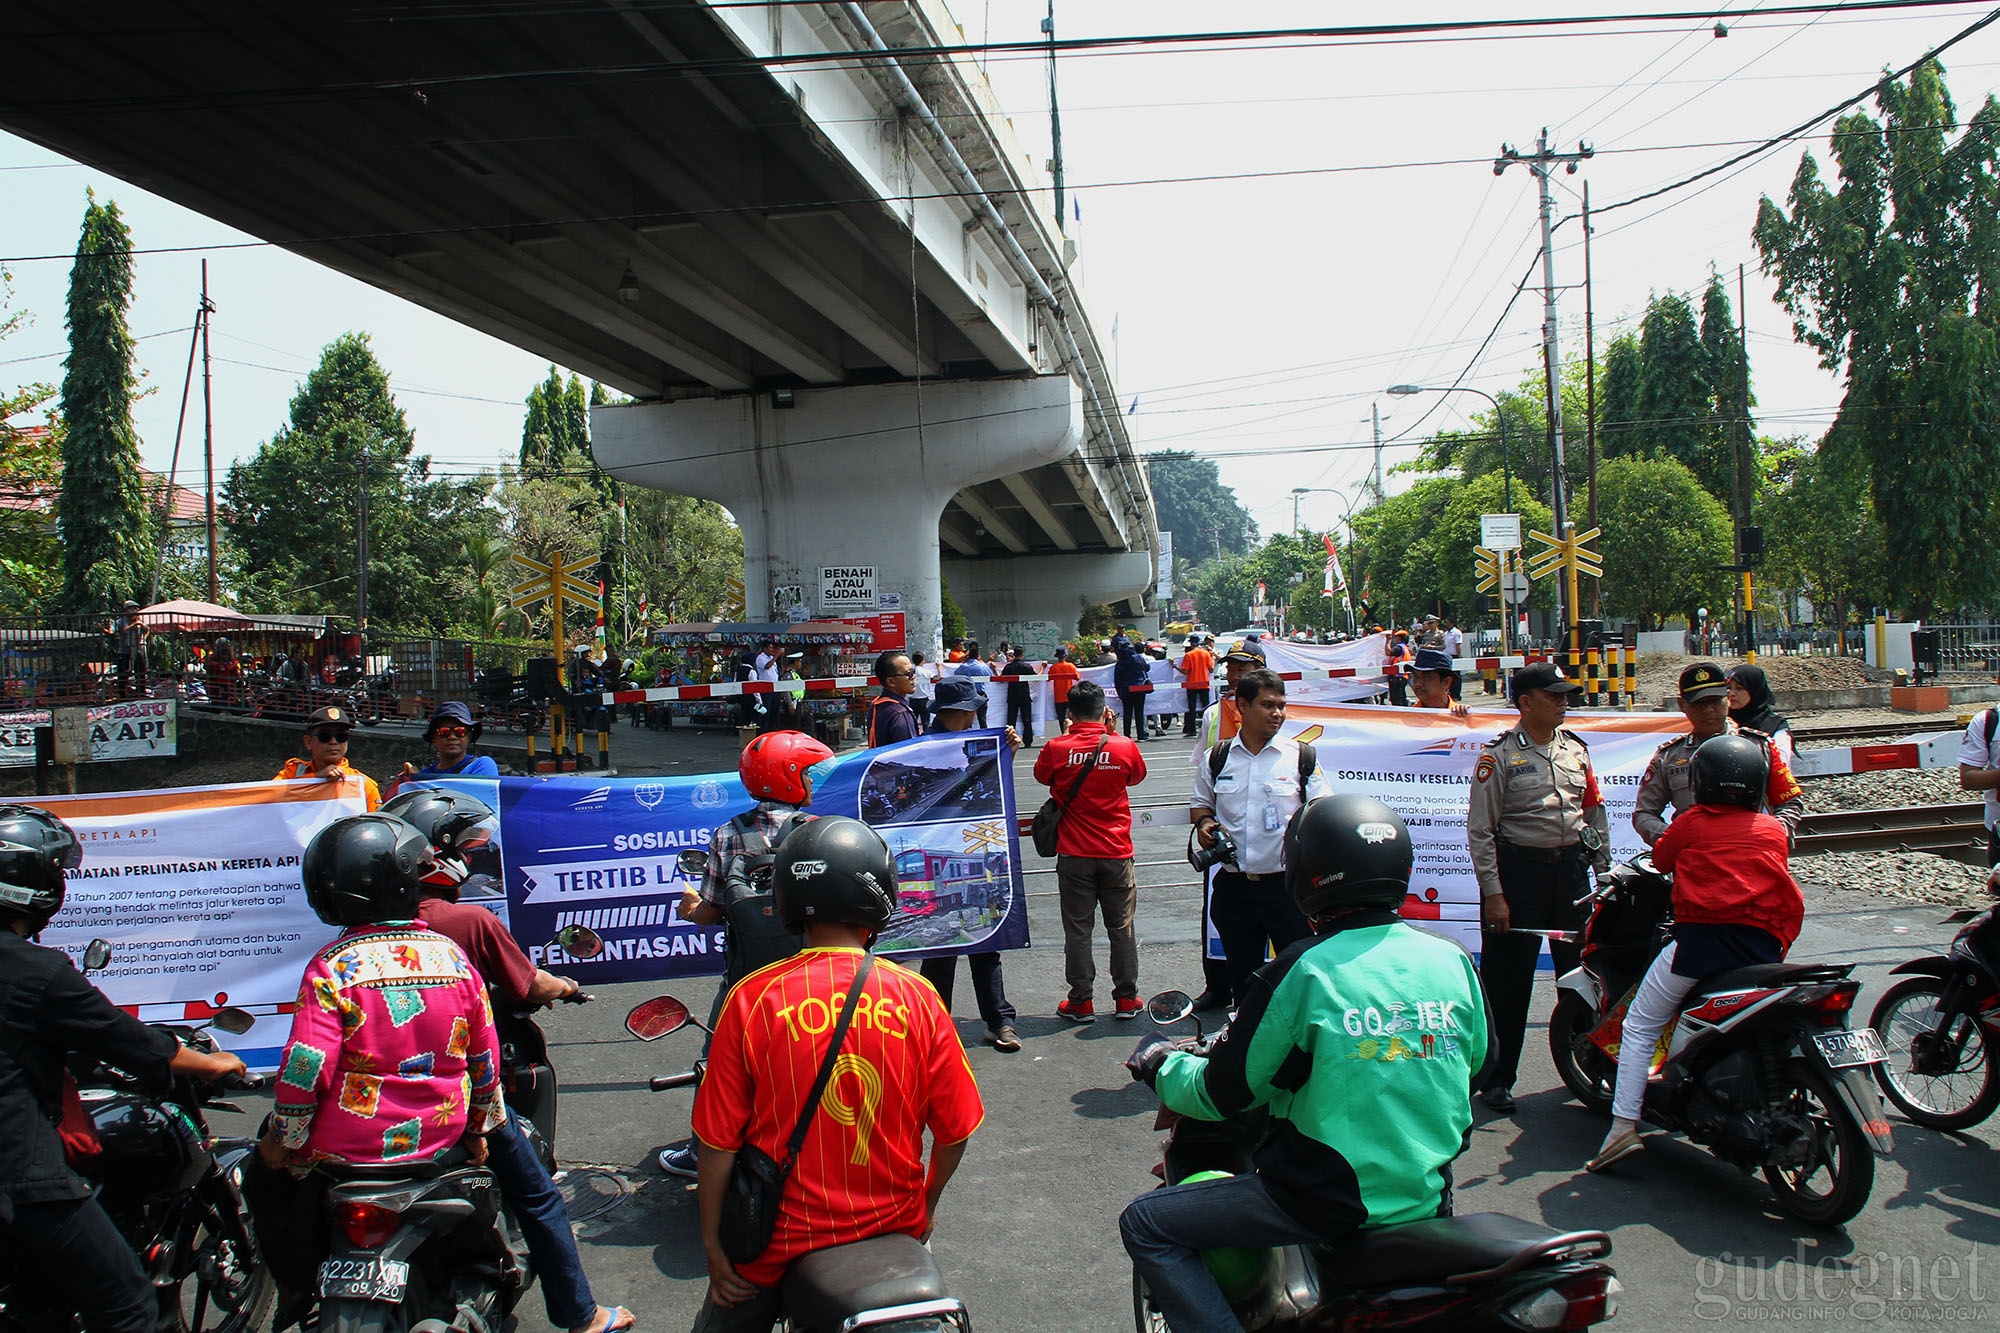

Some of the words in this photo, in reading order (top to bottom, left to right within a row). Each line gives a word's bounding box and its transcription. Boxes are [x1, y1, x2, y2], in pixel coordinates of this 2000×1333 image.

[824, 568, 873, 578] BENAHI
[832, 579, 865, 588] ATAU
[825, 589, 872, 599] SUDAHI
[114, 702, 168, 719] BATU
[116, 720, 166, 740] API
[1338, 770, 1415, 783] SOSIALISASI
[1383, 794, 1422, 805] Undang
[1424, 796, 1457, 804] Nomor
[1392, 806, 1430, 814] emakai
[1431, 806, 1456, 816] jalan
[80, 831, 121, 841] RETA
[128, 828, 157, 839] API
[613, 828, 716, 852] SOSIALIS
[124, 861, 217, 876] PERLINTASAN
[222, 858, 272, 870] KERETA
[276, 855, 300, 867] API
[1418, 855, 1450, 863] rambu
[1453, 855, 1471, 864] lalu
[794, 863, 826, 873] BMC
[1415, 867, 1476, 876] mengaman
[554, 866, 647, 892] TERTIB
[1312, 871, 1345, 889] Touring
[74, 893, 106, 902] Tahun
[108, 891, 133, 901] 2007
[135, 889, 176, 899] tentang
[179, 884, 261, 898] perkeretaapian
[263, 882, 301, 893] bahwa
[85, 904, 112, 915] yang
[114, 902, 156, 913] hendak
[158, 899, 204, 910] melintas
[205, 898, 230, 910] jalur
[231, 897, 265, 907] kereta
[267, 895, 286, 906] api
[116, 915, 175, 927] perjalanan
[177, 912, 211, 922] kereta
[128, 938, 203, 952] pengamanan
[205, 936, 240, 946] utama
[242, 934, 265, 944] dan
[267, 932, 301, 943] bukan
[143, 951, 194, 962] hanyalah
[196, 949, 217, 959] alat
[219, 947, 251, 958] bantu
[253, 945, 283, 956] untuk
[101, 966, 160, 978] perjalanan
[162, 963, 197, 974] kereta
[775, 991, 911, 1043] TORRES
[1343, 1006, 1383, 1037] GO
[1416, 1000, 1459, 1030] JEK
[1827, 1035, 1857, 1051] 5719
[820, 1053, 882, 1167] 9
